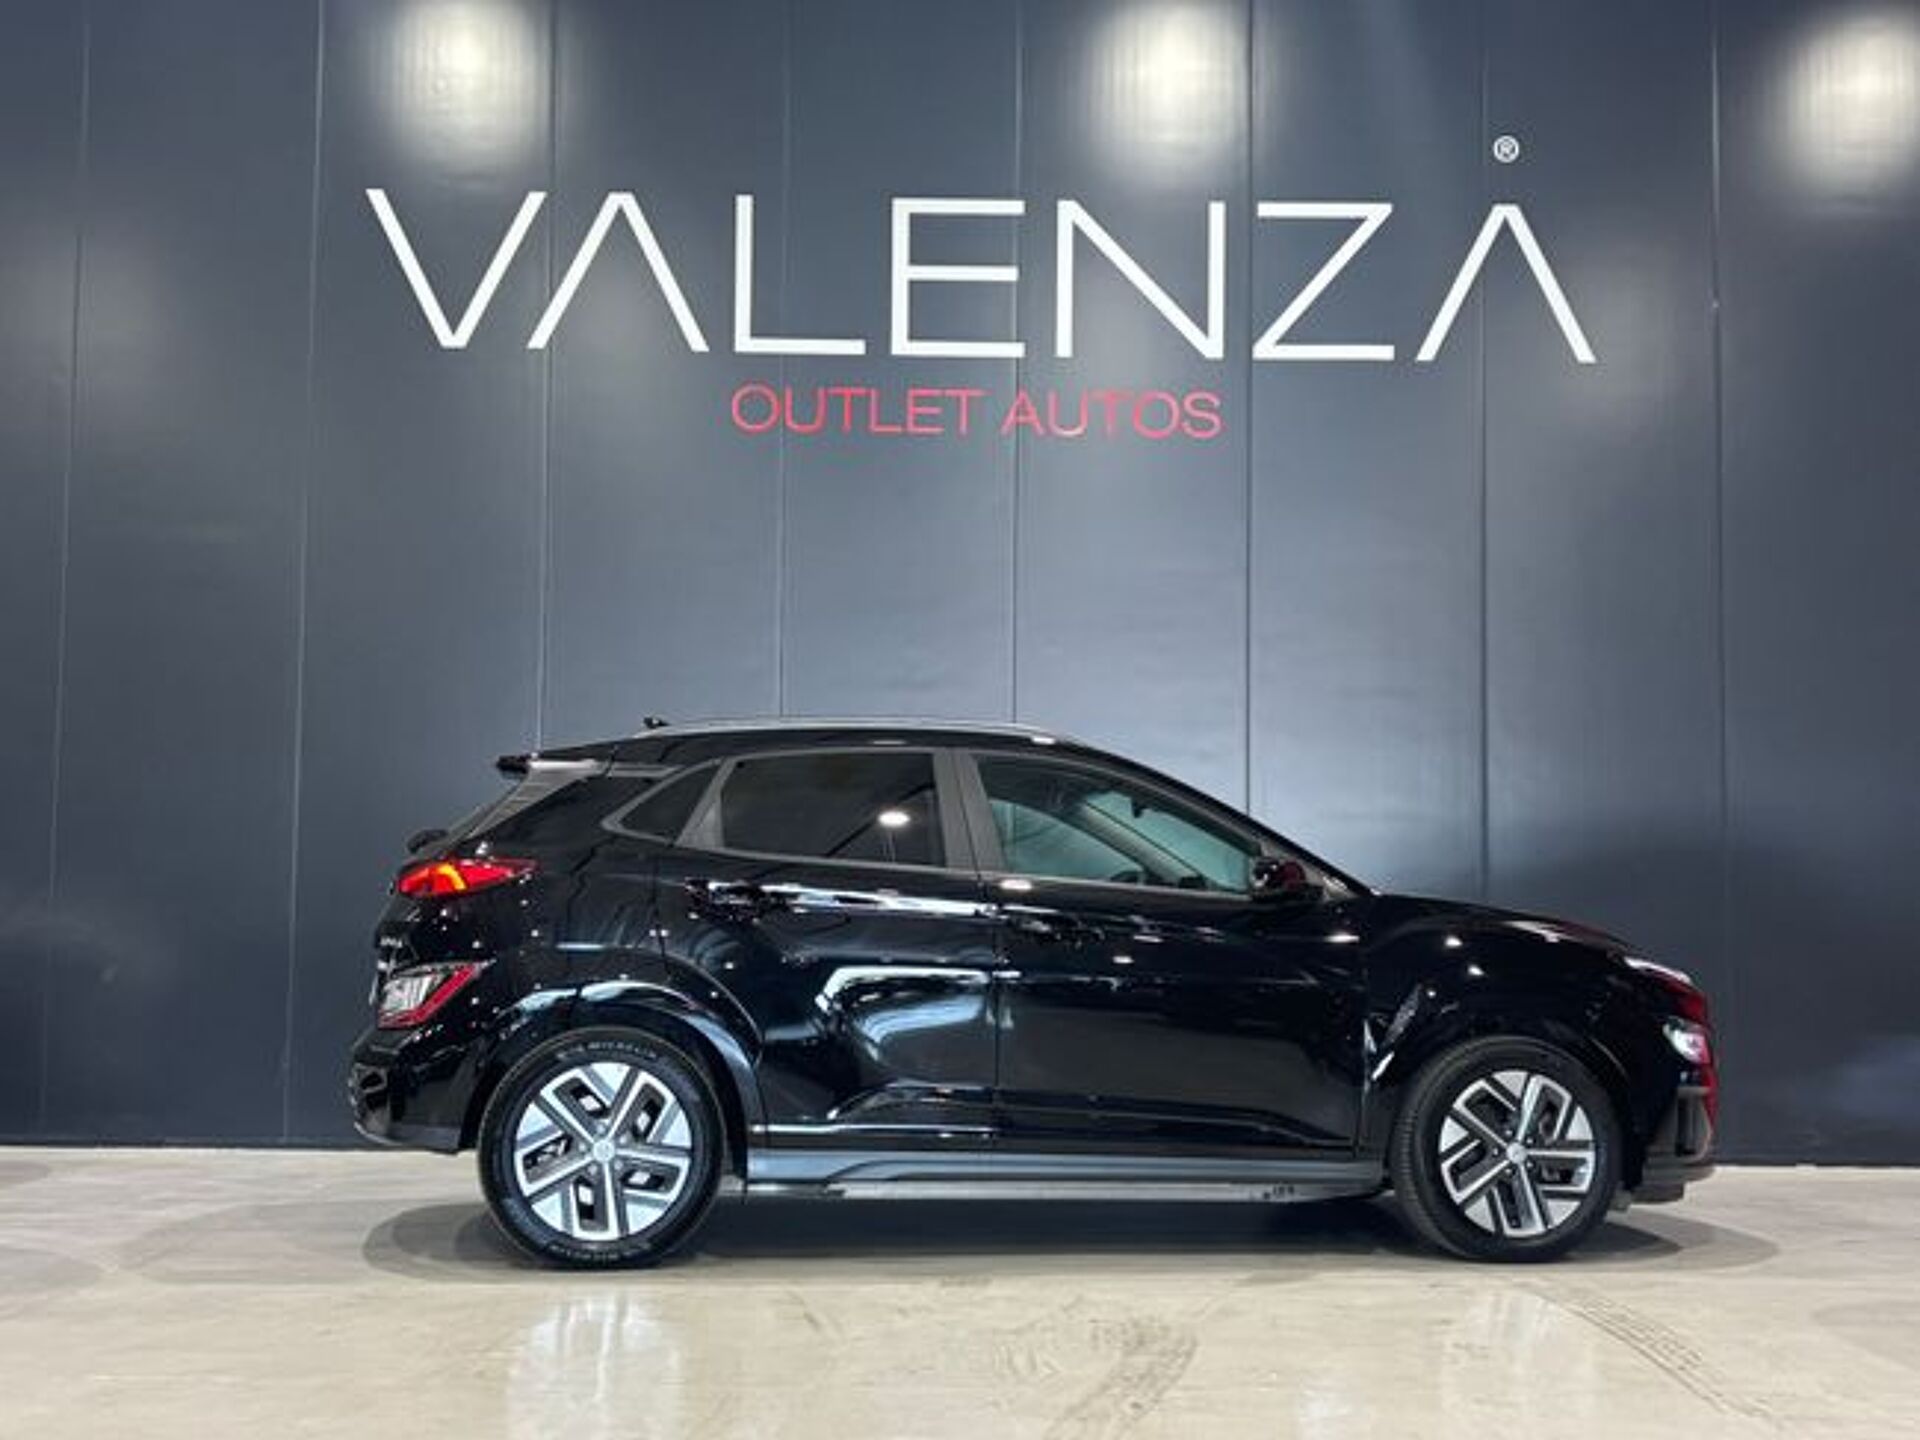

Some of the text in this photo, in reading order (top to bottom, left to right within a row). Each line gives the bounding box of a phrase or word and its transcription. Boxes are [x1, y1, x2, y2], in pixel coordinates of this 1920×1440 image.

[366, 188, 1597, 365] VALENZA
[730, 384, 1224, 441] OUTLET AUTOS
